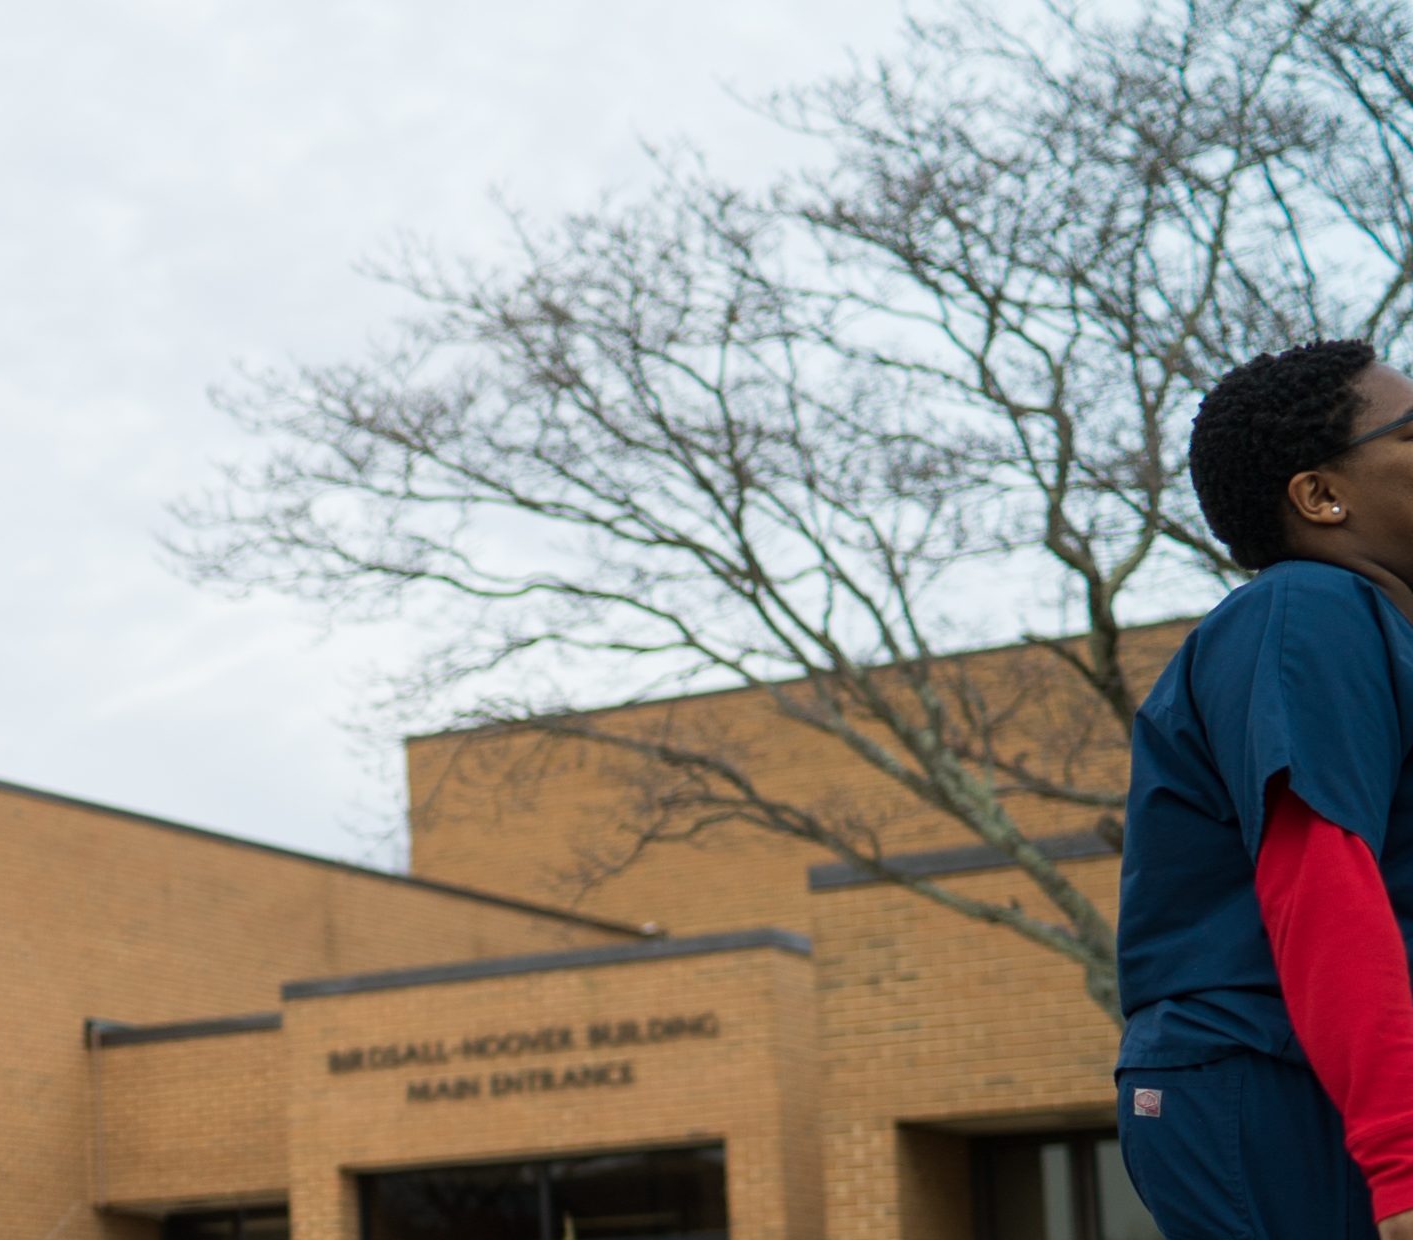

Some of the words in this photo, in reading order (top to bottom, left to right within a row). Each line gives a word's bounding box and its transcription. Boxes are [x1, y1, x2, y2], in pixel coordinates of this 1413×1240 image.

[587, 1012, 718, 1047] BUILDING
[407, 1074, 480, 1102] MAIN
[490, 1060, 634, 1097] ENTRANCE
